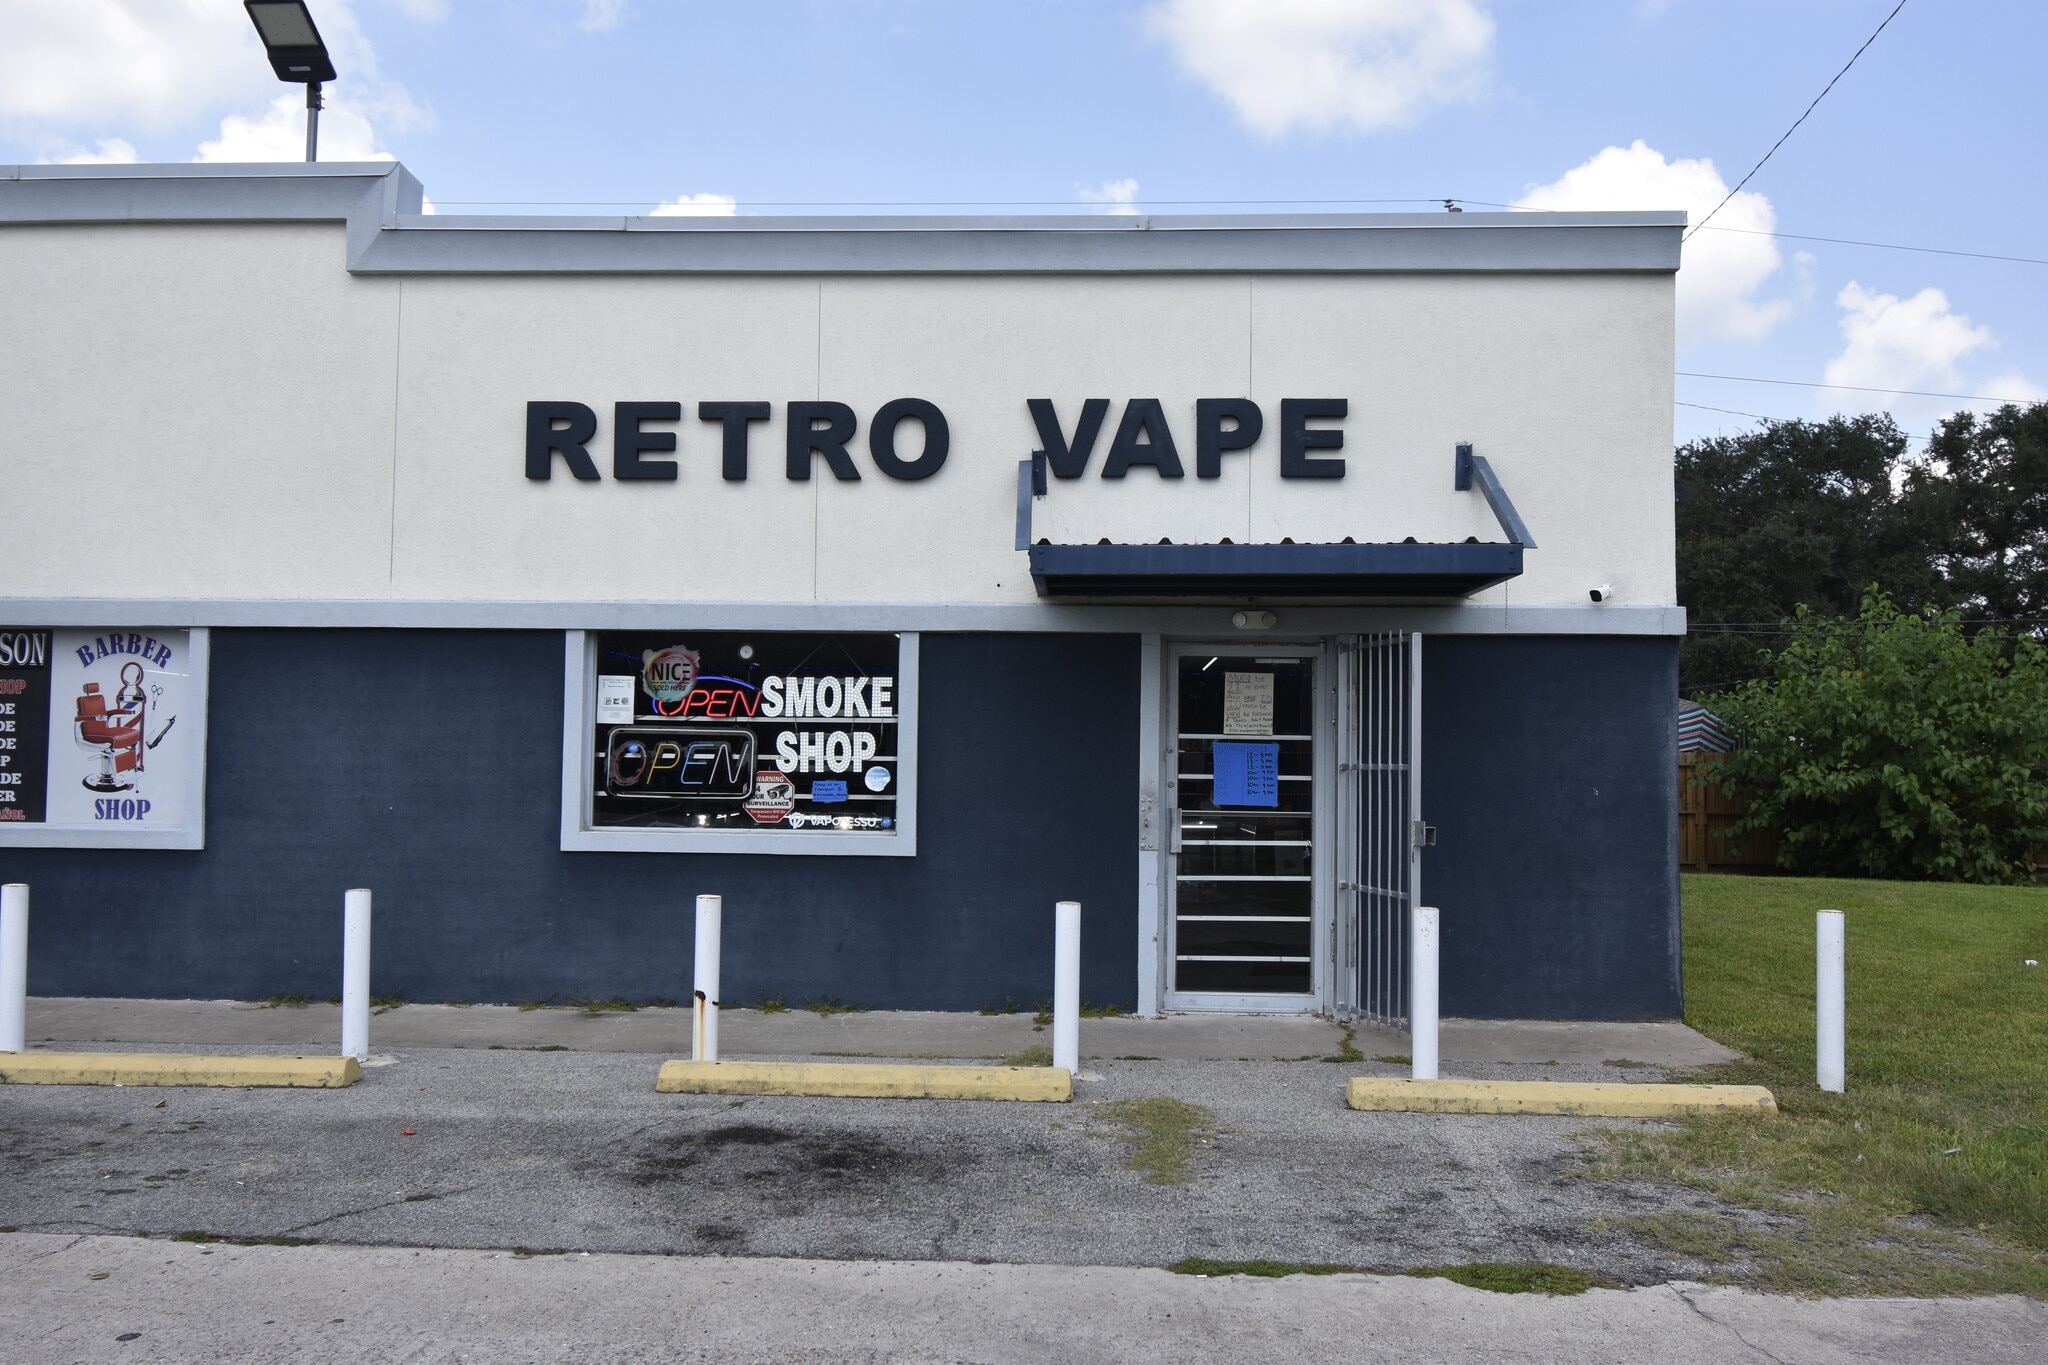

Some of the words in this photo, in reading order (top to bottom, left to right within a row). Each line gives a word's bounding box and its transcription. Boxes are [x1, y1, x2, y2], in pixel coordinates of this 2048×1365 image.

[525, 398, 949, 481] RETRO
[1027, 398, 1348, 479] VAPE
[75, 633, 172, 669] BARBER
[652, 663, 690, 681] NICE
[761, 675, 893, 718] SMOKE
[613, 740, 750, 786] OPEN
[776, 730, 876, 773] SHOP
[95, 799, 151, 820] SHOP
